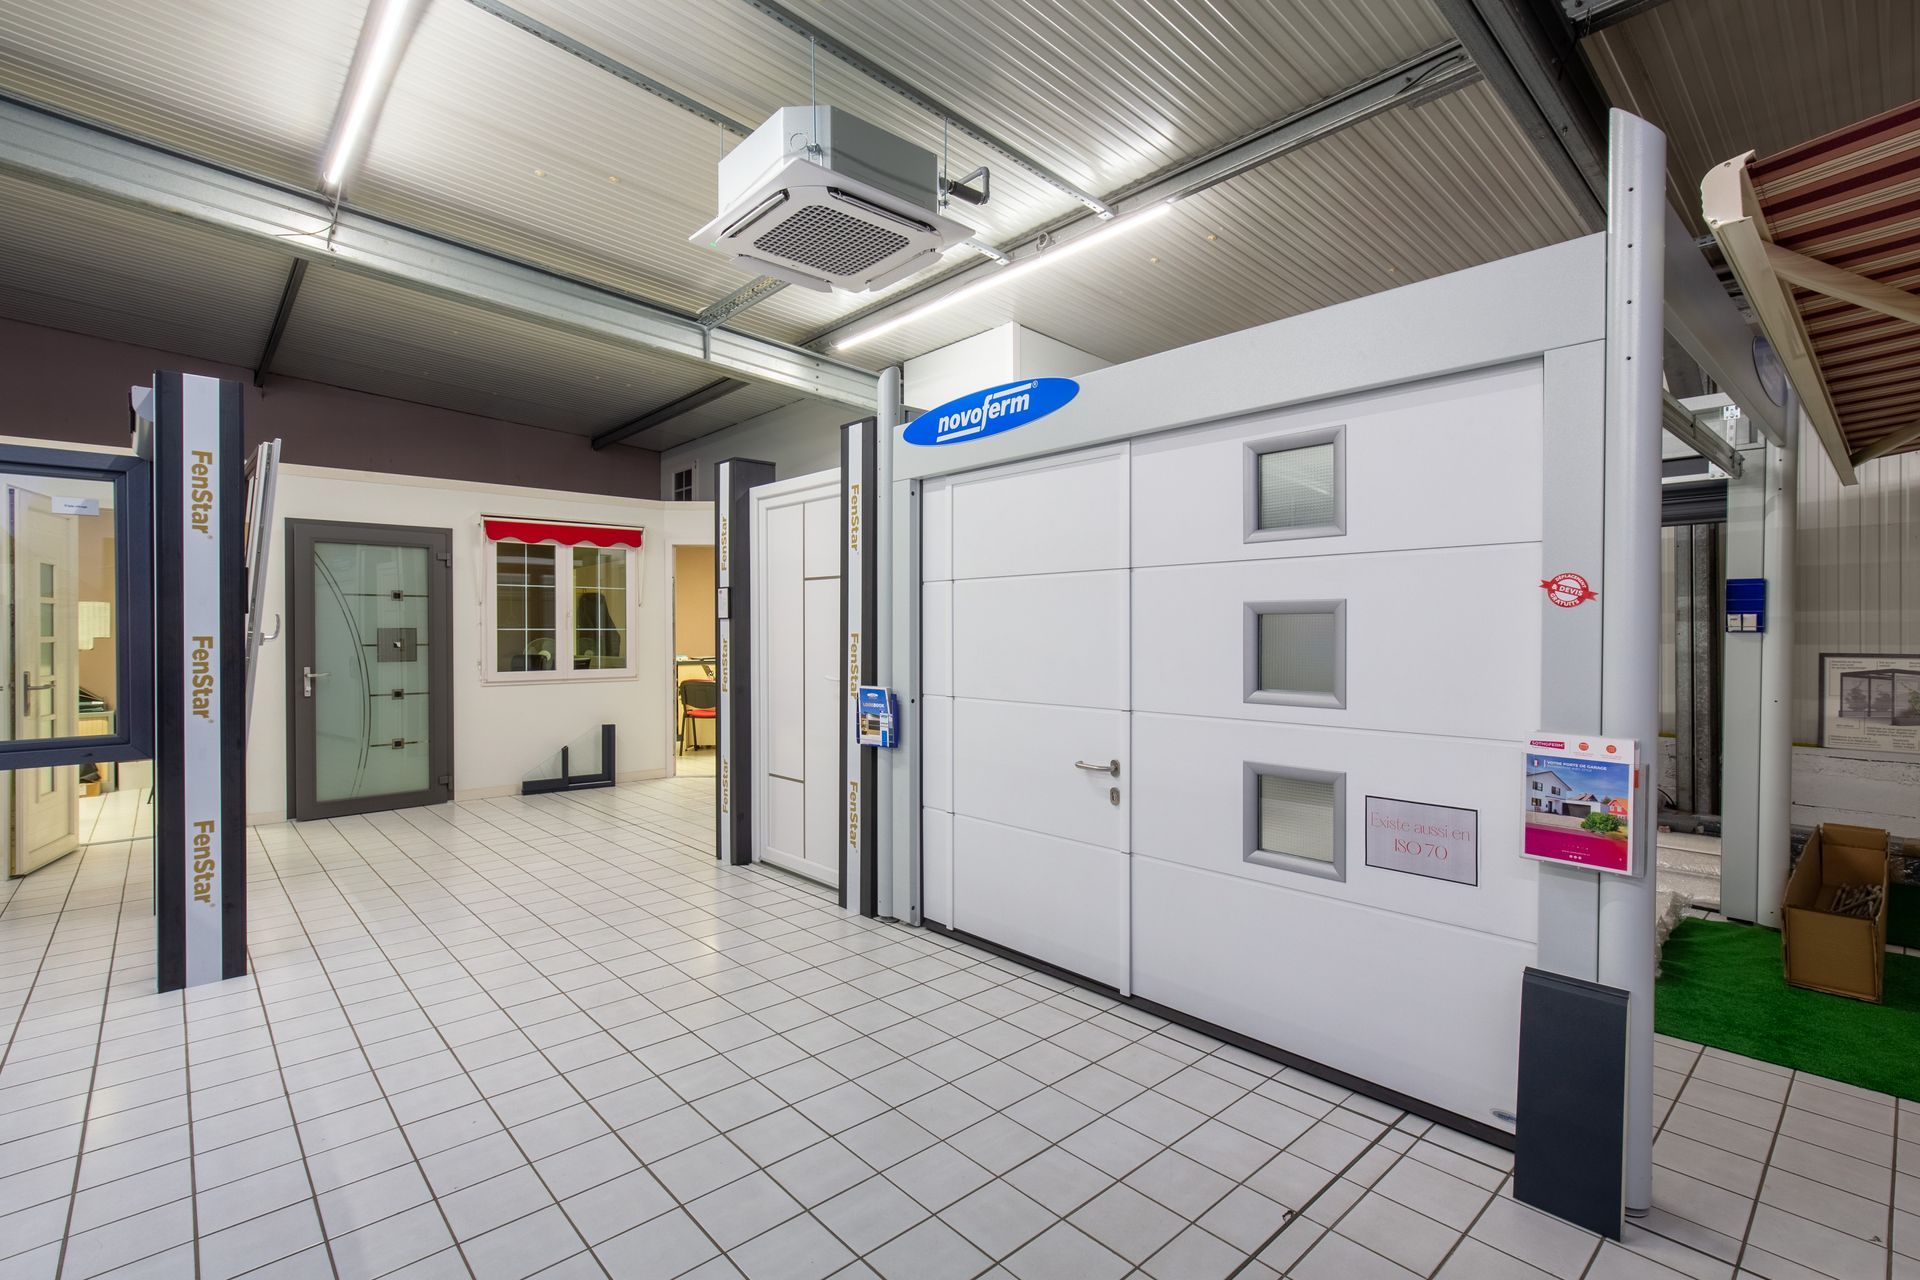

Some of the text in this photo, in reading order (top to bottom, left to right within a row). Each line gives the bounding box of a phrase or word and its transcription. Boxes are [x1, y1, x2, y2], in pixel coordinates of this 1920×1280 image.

[937, 393, 1030, 433] novoferm
[191, 449, 213, 533] FenStar
[851, 484, 861, 551] FenStar
[1550, 592, 1580, 606] GRATUITS
[1559, 585, 1583, 596] DEVIS
[192, 635, 213, 718] FenStar
[850, 780, 859, 848] FenStar
[1370, 811, 1471, 842] Existe aussi en
[193, 819, 215, 903] FenStar
[1394, 838, 1448, 861] ISO 70
